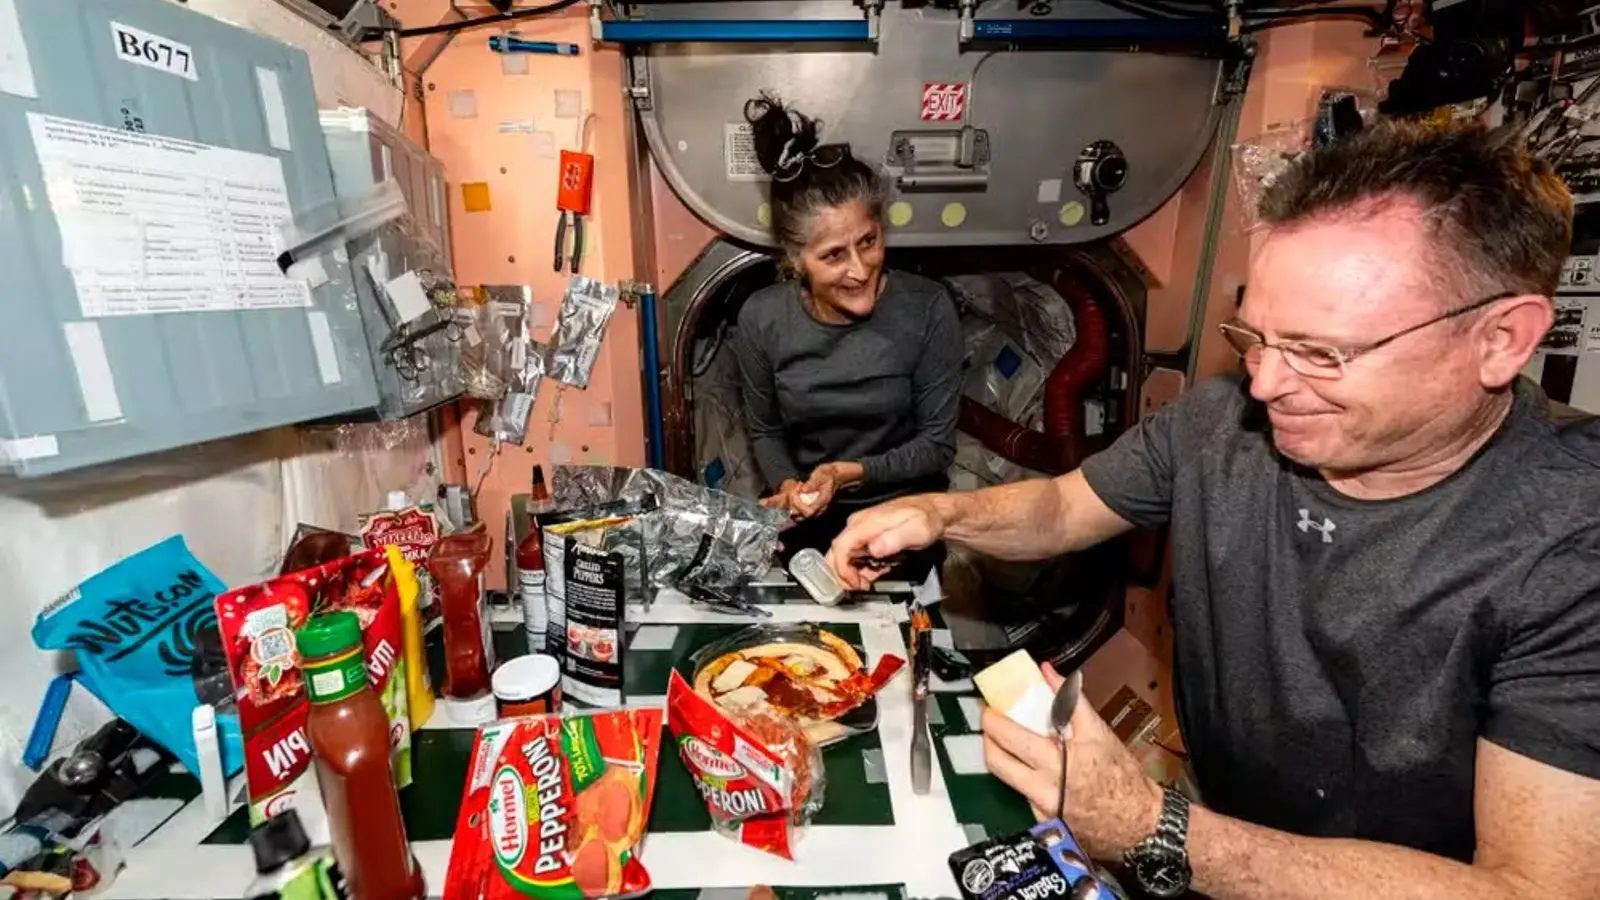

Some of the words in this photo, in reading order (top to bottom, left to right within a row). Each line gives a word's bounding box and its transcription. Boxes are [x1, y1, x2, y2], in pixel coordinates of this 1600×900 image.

[118, 30, 189, 72] B677
[929, 93, 958, 111] EXIT
[573, 566, 604, 585] PEPPERS
[692, 743, 737, 772] Hormel
[500, 779, 520, 851] Hormel
[522, 736, 566, 874] PEPPERONI
[1017, 873, 1066, 898] Snack
